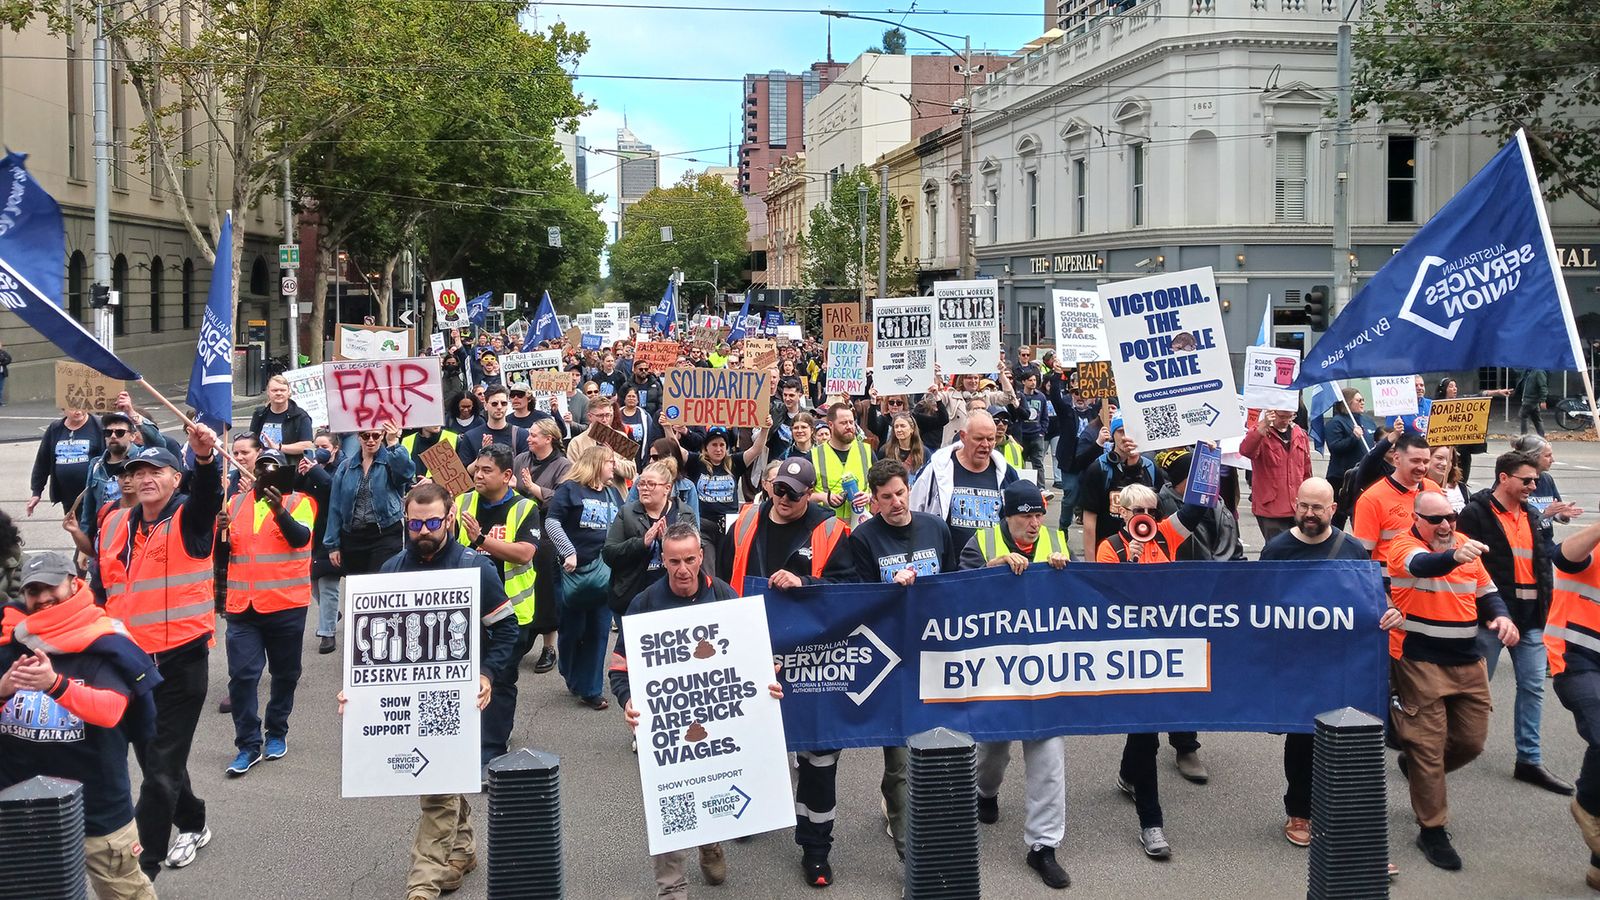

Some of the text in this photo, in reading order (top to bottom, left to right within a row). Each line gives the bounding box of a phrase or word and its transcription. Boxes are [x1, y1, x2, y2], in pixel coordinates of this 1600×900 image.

[1054, 254, 1098, 272] IMPERIAL
[1107, 283, 1211, 318] VICTORIA.
[826, 307, 852, 323] FAIR
[877, 306, 930, 315] COUNCIL WORKERS
[833, 324, 848, 338] PA
[850, 326, 869, 335] FAIR
[1144, 310, 1182, 335] THE
[201, 315, 232, 364] VICES
[830, 342, 866, 355] LIBRARY
[1120, 328, 1216, 362] POTHLE
[197, 335, 216, 367] ION
[835, 356, 861, 367] STAFF
[1079, 362, 1108, 378] FAIR
[1144, 354, 1201, 382] STATE
[828, 367, 863, 379] DESERVE
[1376, 377, 1410, 386] WORKERS
[67, 384, 105, 397] FAIR
[333, 364, 434, 411] FAIR
[535, 381, 570, 390] FAIR PAY
[668, 369, 766, 400] SOLIDARITY
[827, 380, 863, 392] FAIR PAY
[1080, 378, 1101, 389] PAY
[1382, 386, 1398, 397] NO
[354, 403, 413, 428] PAY
[684, 399, 759, 426] FOREVER
[1181, 410, 1211, 419] SERVICES
[1447, 413, 1474, 423] AHEAD
[422, 442, 454, 469] MISS
[437, 462, 457, 481] US
[880, 555, 907, 566] COUNCIL
[355, 591, 469, 610] COUNCIL WORKERS
[921, 604, 1354, 641] AUSTRALIAN SERVICES UNION
[640, 623, 719, 651] SICK OF
[795, 639, 849, 653] AUSTRALIAN
[641, 638, 730, 668] THIS ?
[773, 646, 872, 668] SERVICES
[354, 664, 469, 684] DESERVE FAIR PAY
[785, 664, 855, 682] UNION
[943, 649, 1184, 689] BY YOUR SIDE
[646, 667, 741, 697] COUNCIL
[380, 696, 411, 708] SHOW
[647, 681, 757, 715] WORKERS
[384, 711, 410, 722] YOUR
[650, 700, 745, 733] ARE SICK
[1, 724, 81, 740] DESERVE FAIR PAY
[363, 724, 411, 736] SUPPORT
[652, 729, 680, 749] OF
[654, 737, 741, 766] WAGES.
[658, 769, 743, 792] SHOW YOUR SUPPORT
[702, 795, 740, 809] SERVICES
[709, 804, 736, 815] UNION
